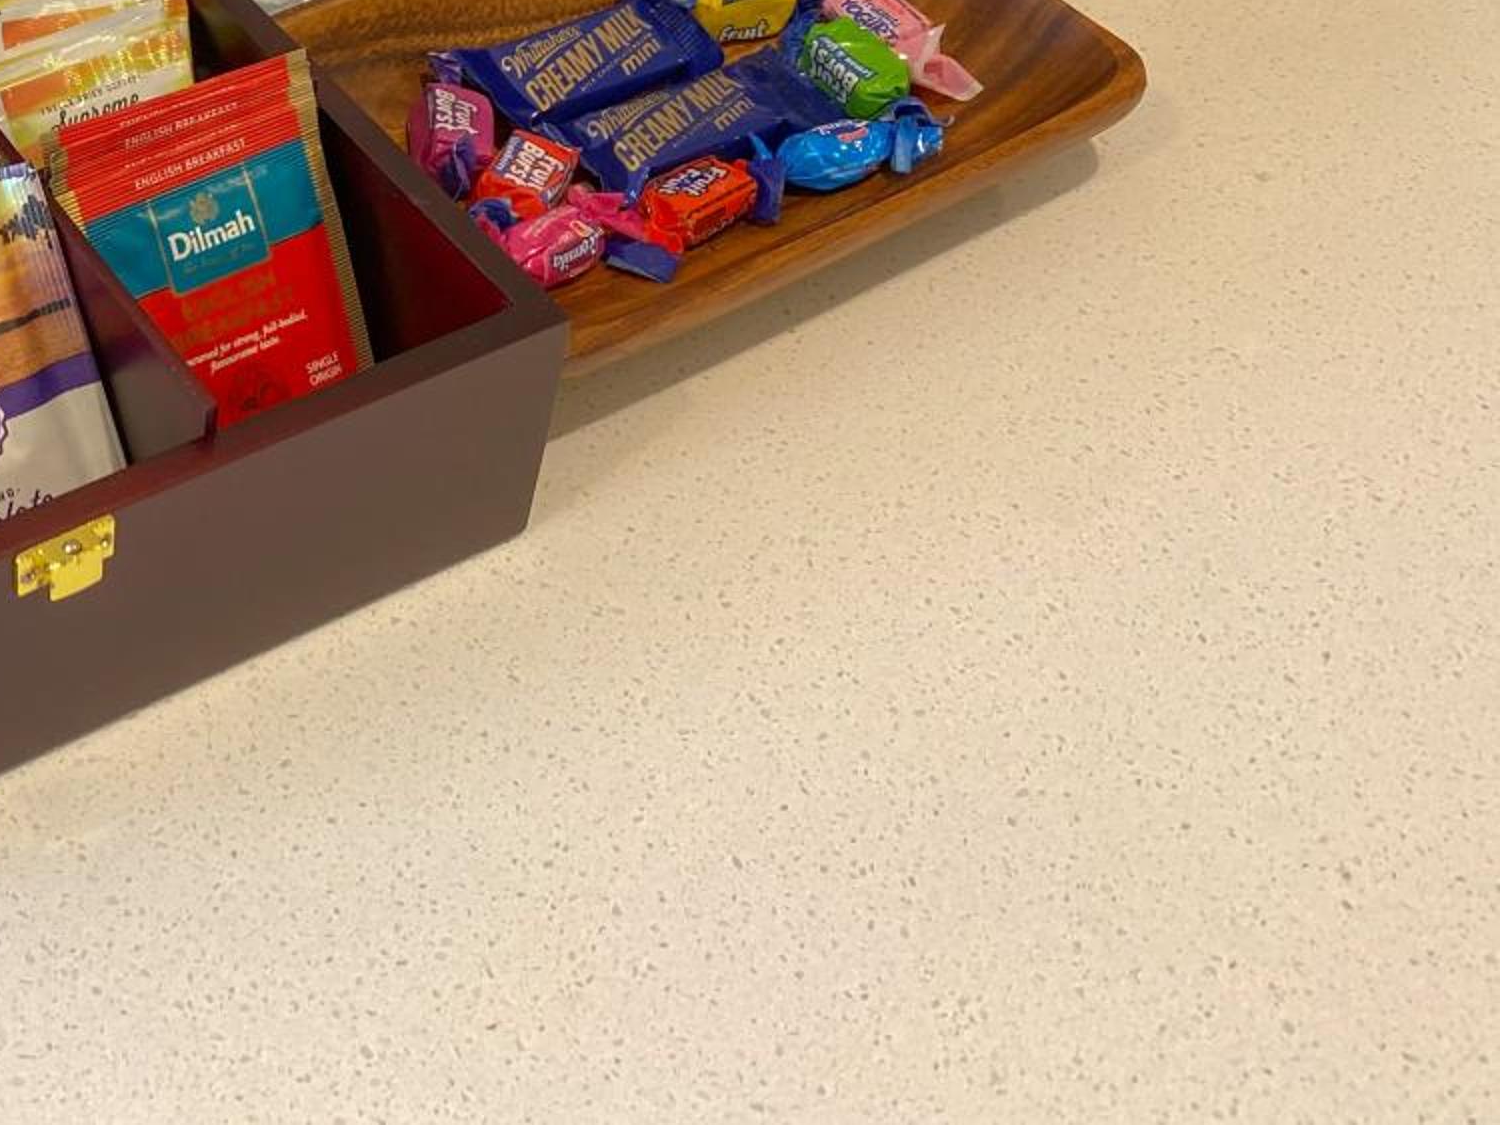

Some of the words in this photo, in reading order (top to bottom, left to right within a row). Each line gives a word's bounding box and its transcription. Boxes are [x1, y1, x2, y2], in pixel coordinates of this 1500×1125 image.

[524, 32, 604, 113] CREAMY
[594, 3, 653, 55] MILK
[619, 33, 663, 77] mini
[434, 87, 458, 132] Burst
[612, 93, 696, 173] CREAMY
[682, 67, 746, 114] MILK
[713, 96, 756, 132] mini
[134, 164, 183, 192] ENGLISH
[184, 137, 247, 172] BREAKFAST
[504, 139, 546, 188] Burst
[167, 208, 256, 262] Dilmah
